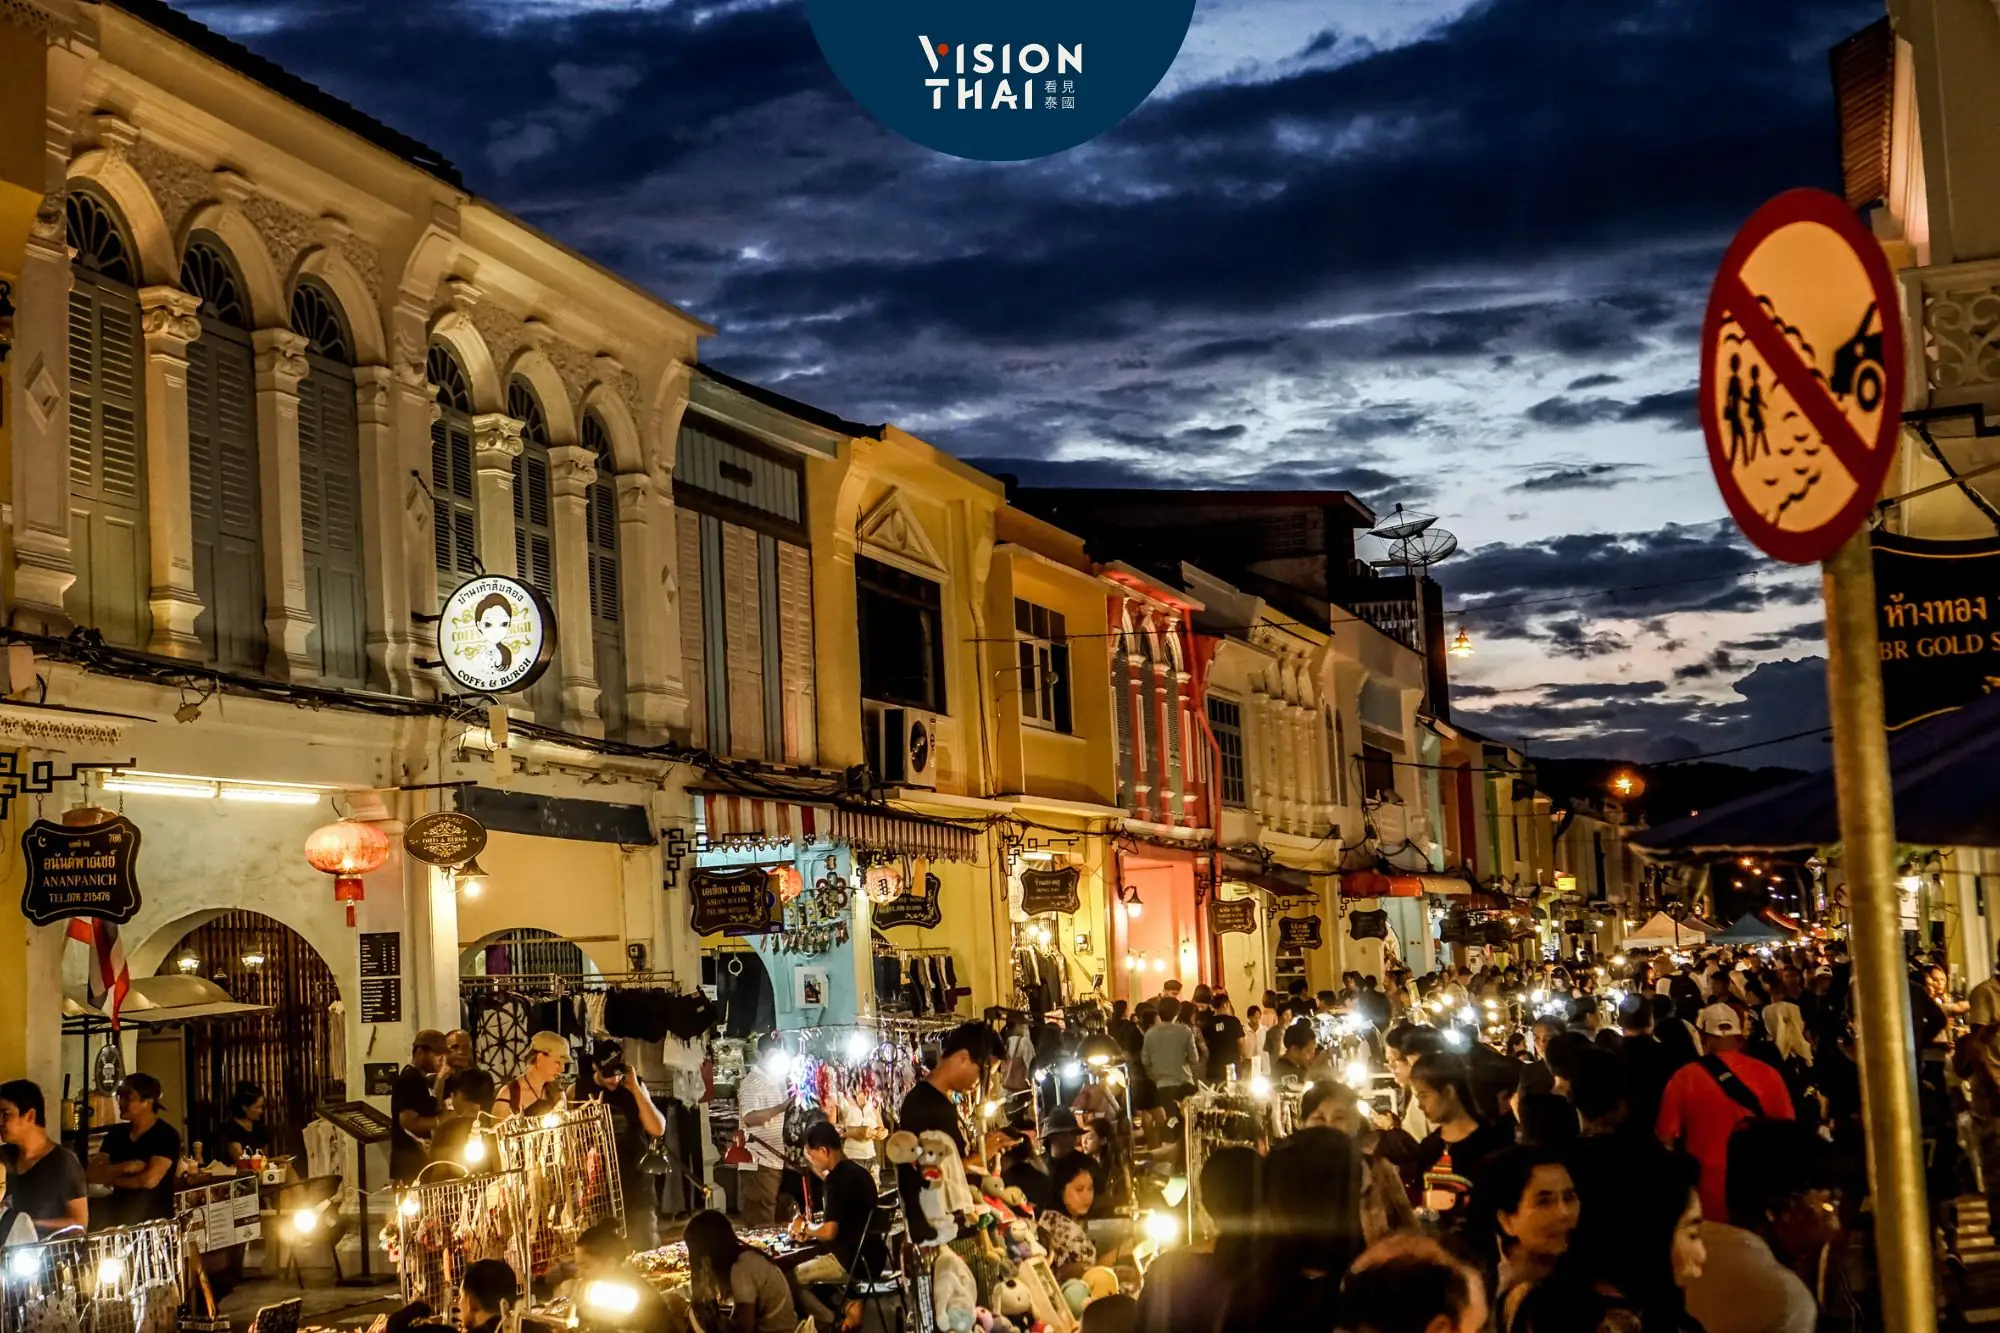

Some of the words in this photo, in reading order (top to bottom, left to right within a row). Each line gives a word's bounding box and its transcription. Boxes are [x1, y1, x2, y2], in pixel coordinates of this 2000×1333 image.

[1883, 592, 1987, 628] ห้างทอง
[1916, 633, 1984, 658] GOLD
[489, 679, 497, 688] &
[500, 657, 532, 687] BURGH
[43, 874, 117, 886] ANANPANICH
